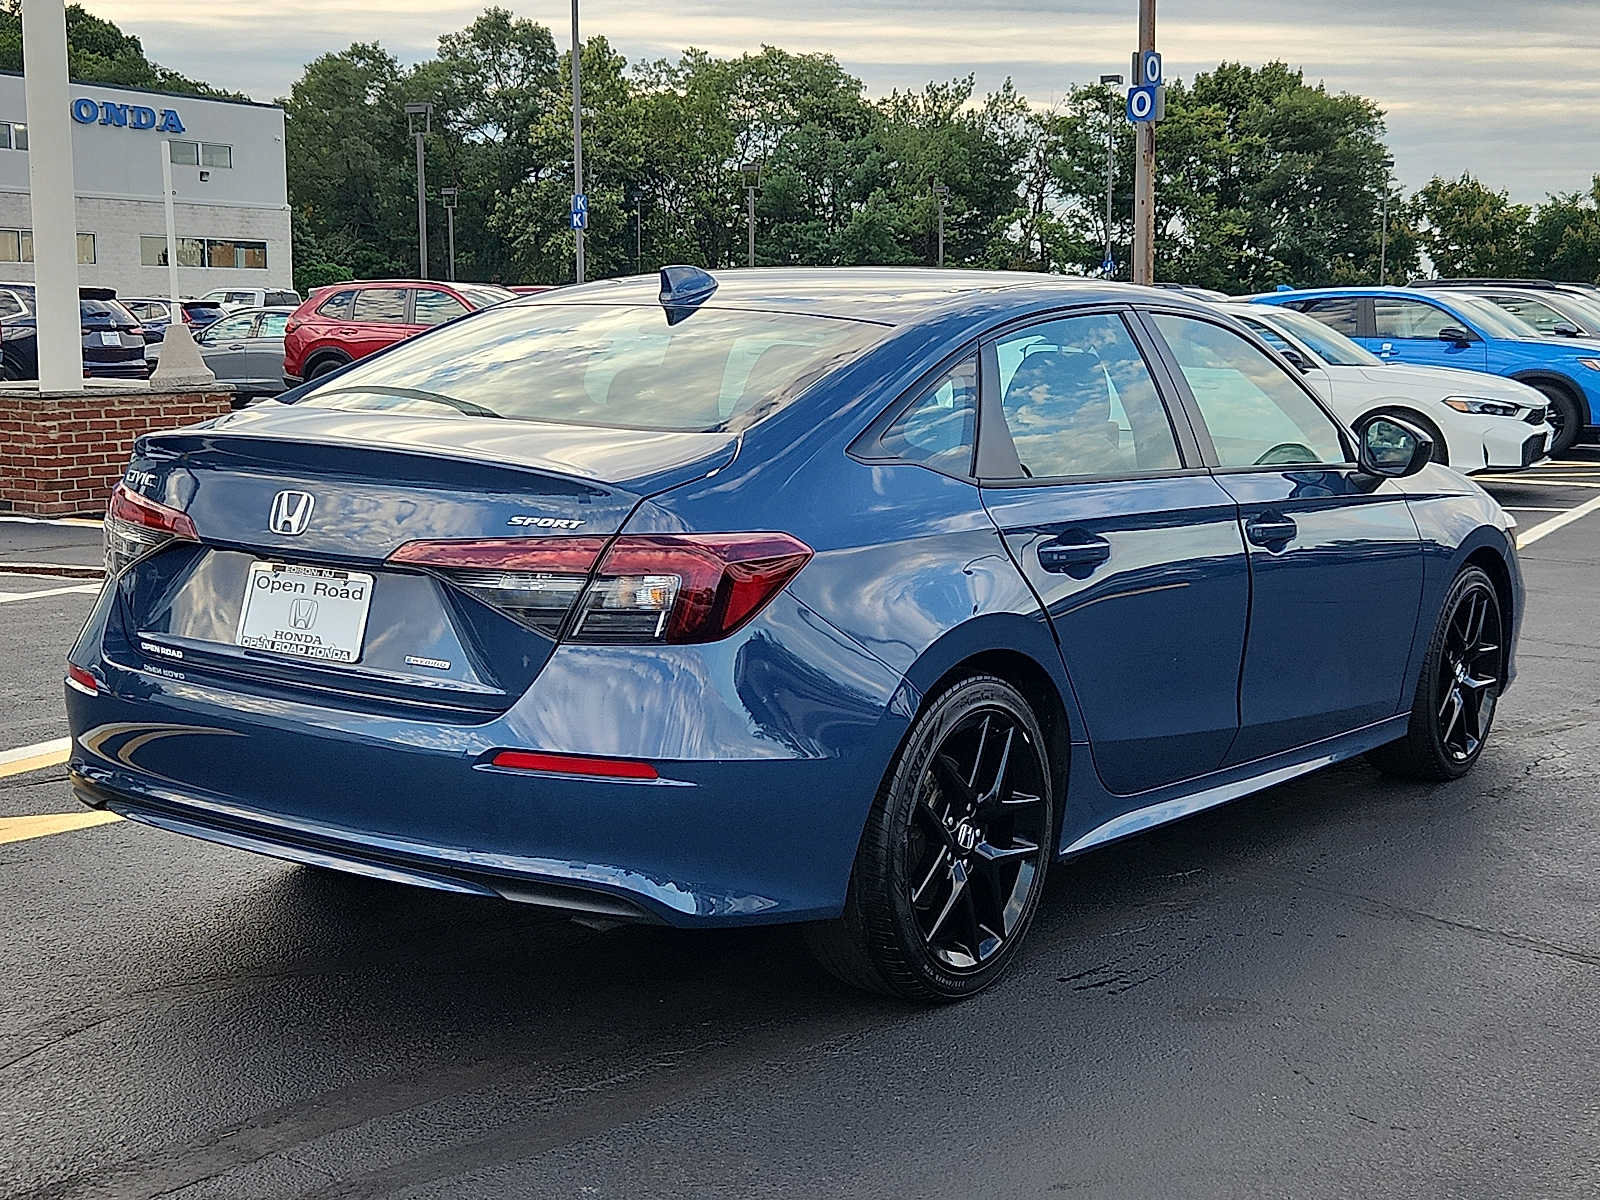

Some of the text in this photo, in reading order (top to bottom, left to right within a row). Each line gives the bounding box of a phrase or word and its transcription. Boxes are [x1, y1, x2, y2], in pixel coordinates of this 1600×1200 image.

[70, 98, 185, 133] ONDA
[577, 196, 586, 210] K
[572, 213, 583, 227] K
[507, 516, 586, 529] SPORT
[321, 569, 335, 578] NJ
[256, 575, 364, 600] Open Road
[273, 630, 323, 645] HONDA
[141, 642, 183, 658] OPEN ROAD
[242, 637, 350, 660] OPEN ROAD HONDA
